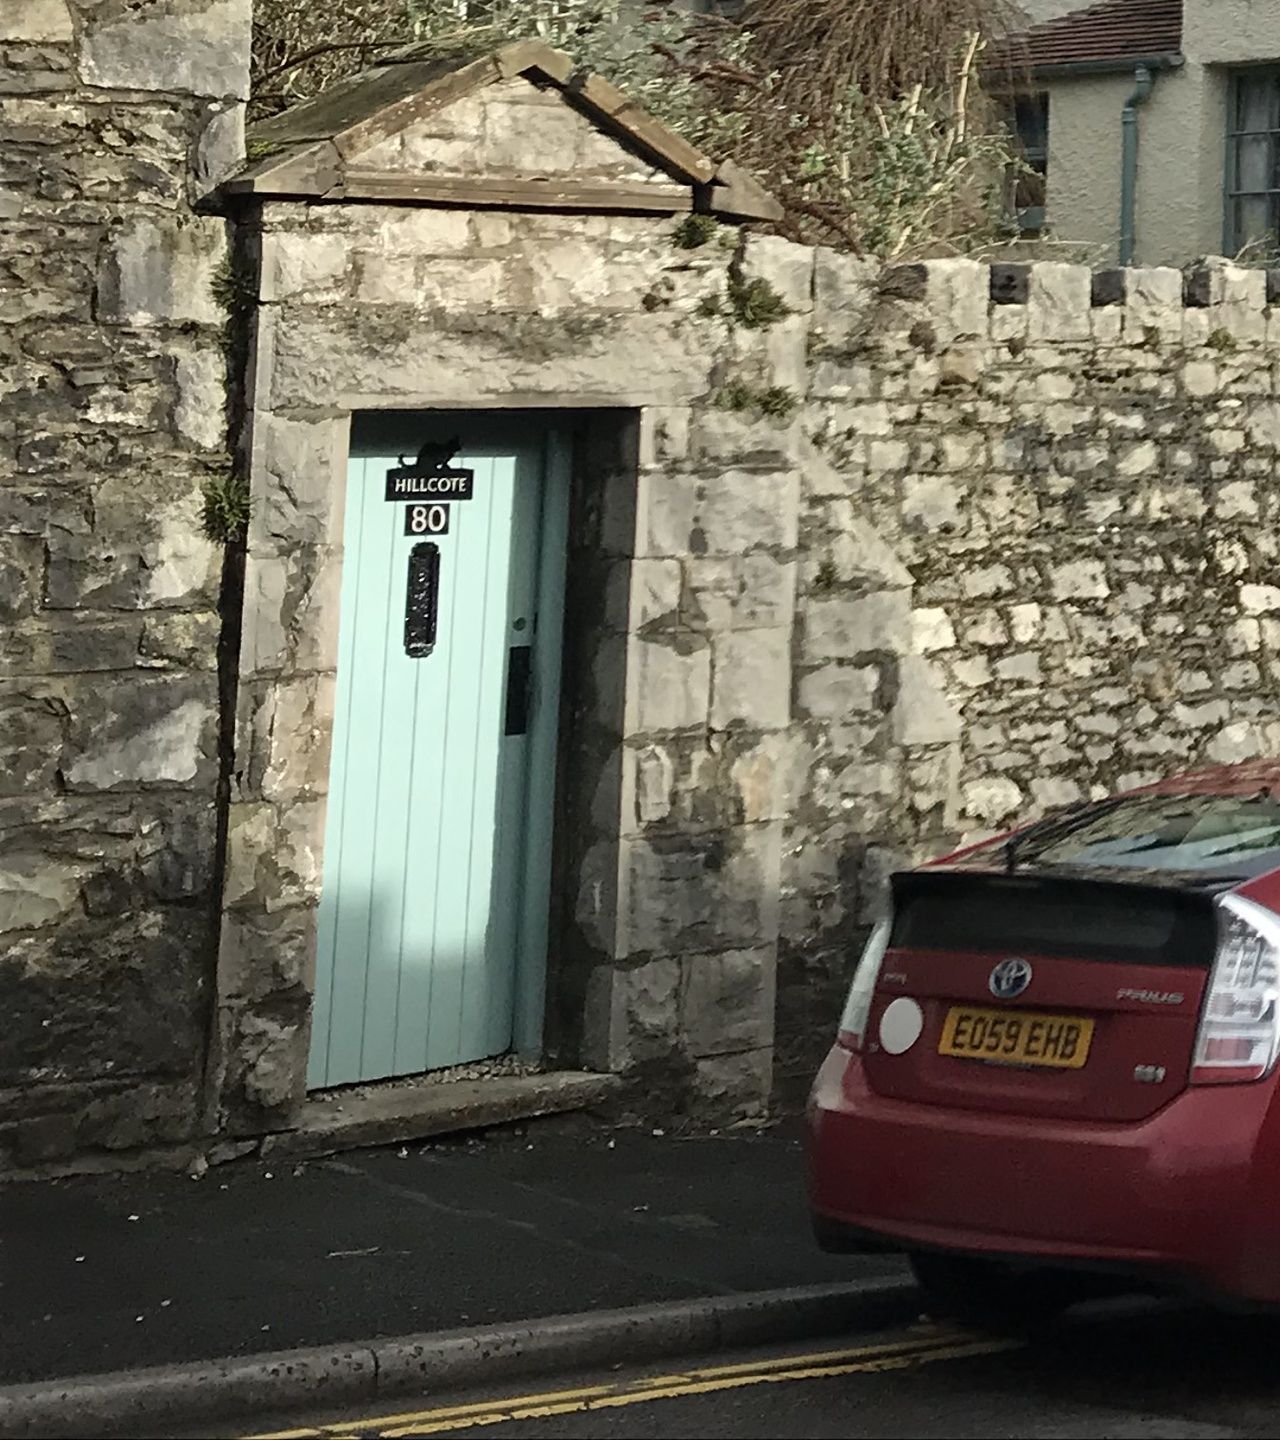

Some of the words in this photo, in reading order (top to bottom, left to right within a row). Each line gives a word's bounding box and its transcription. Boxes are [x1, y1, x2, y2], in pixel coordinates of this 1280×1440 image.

[394, 477, 468, 493] HILLCOTE
[411, 505, 446, 533] 80
[1022, 1019, 1082, 1060] EHB
